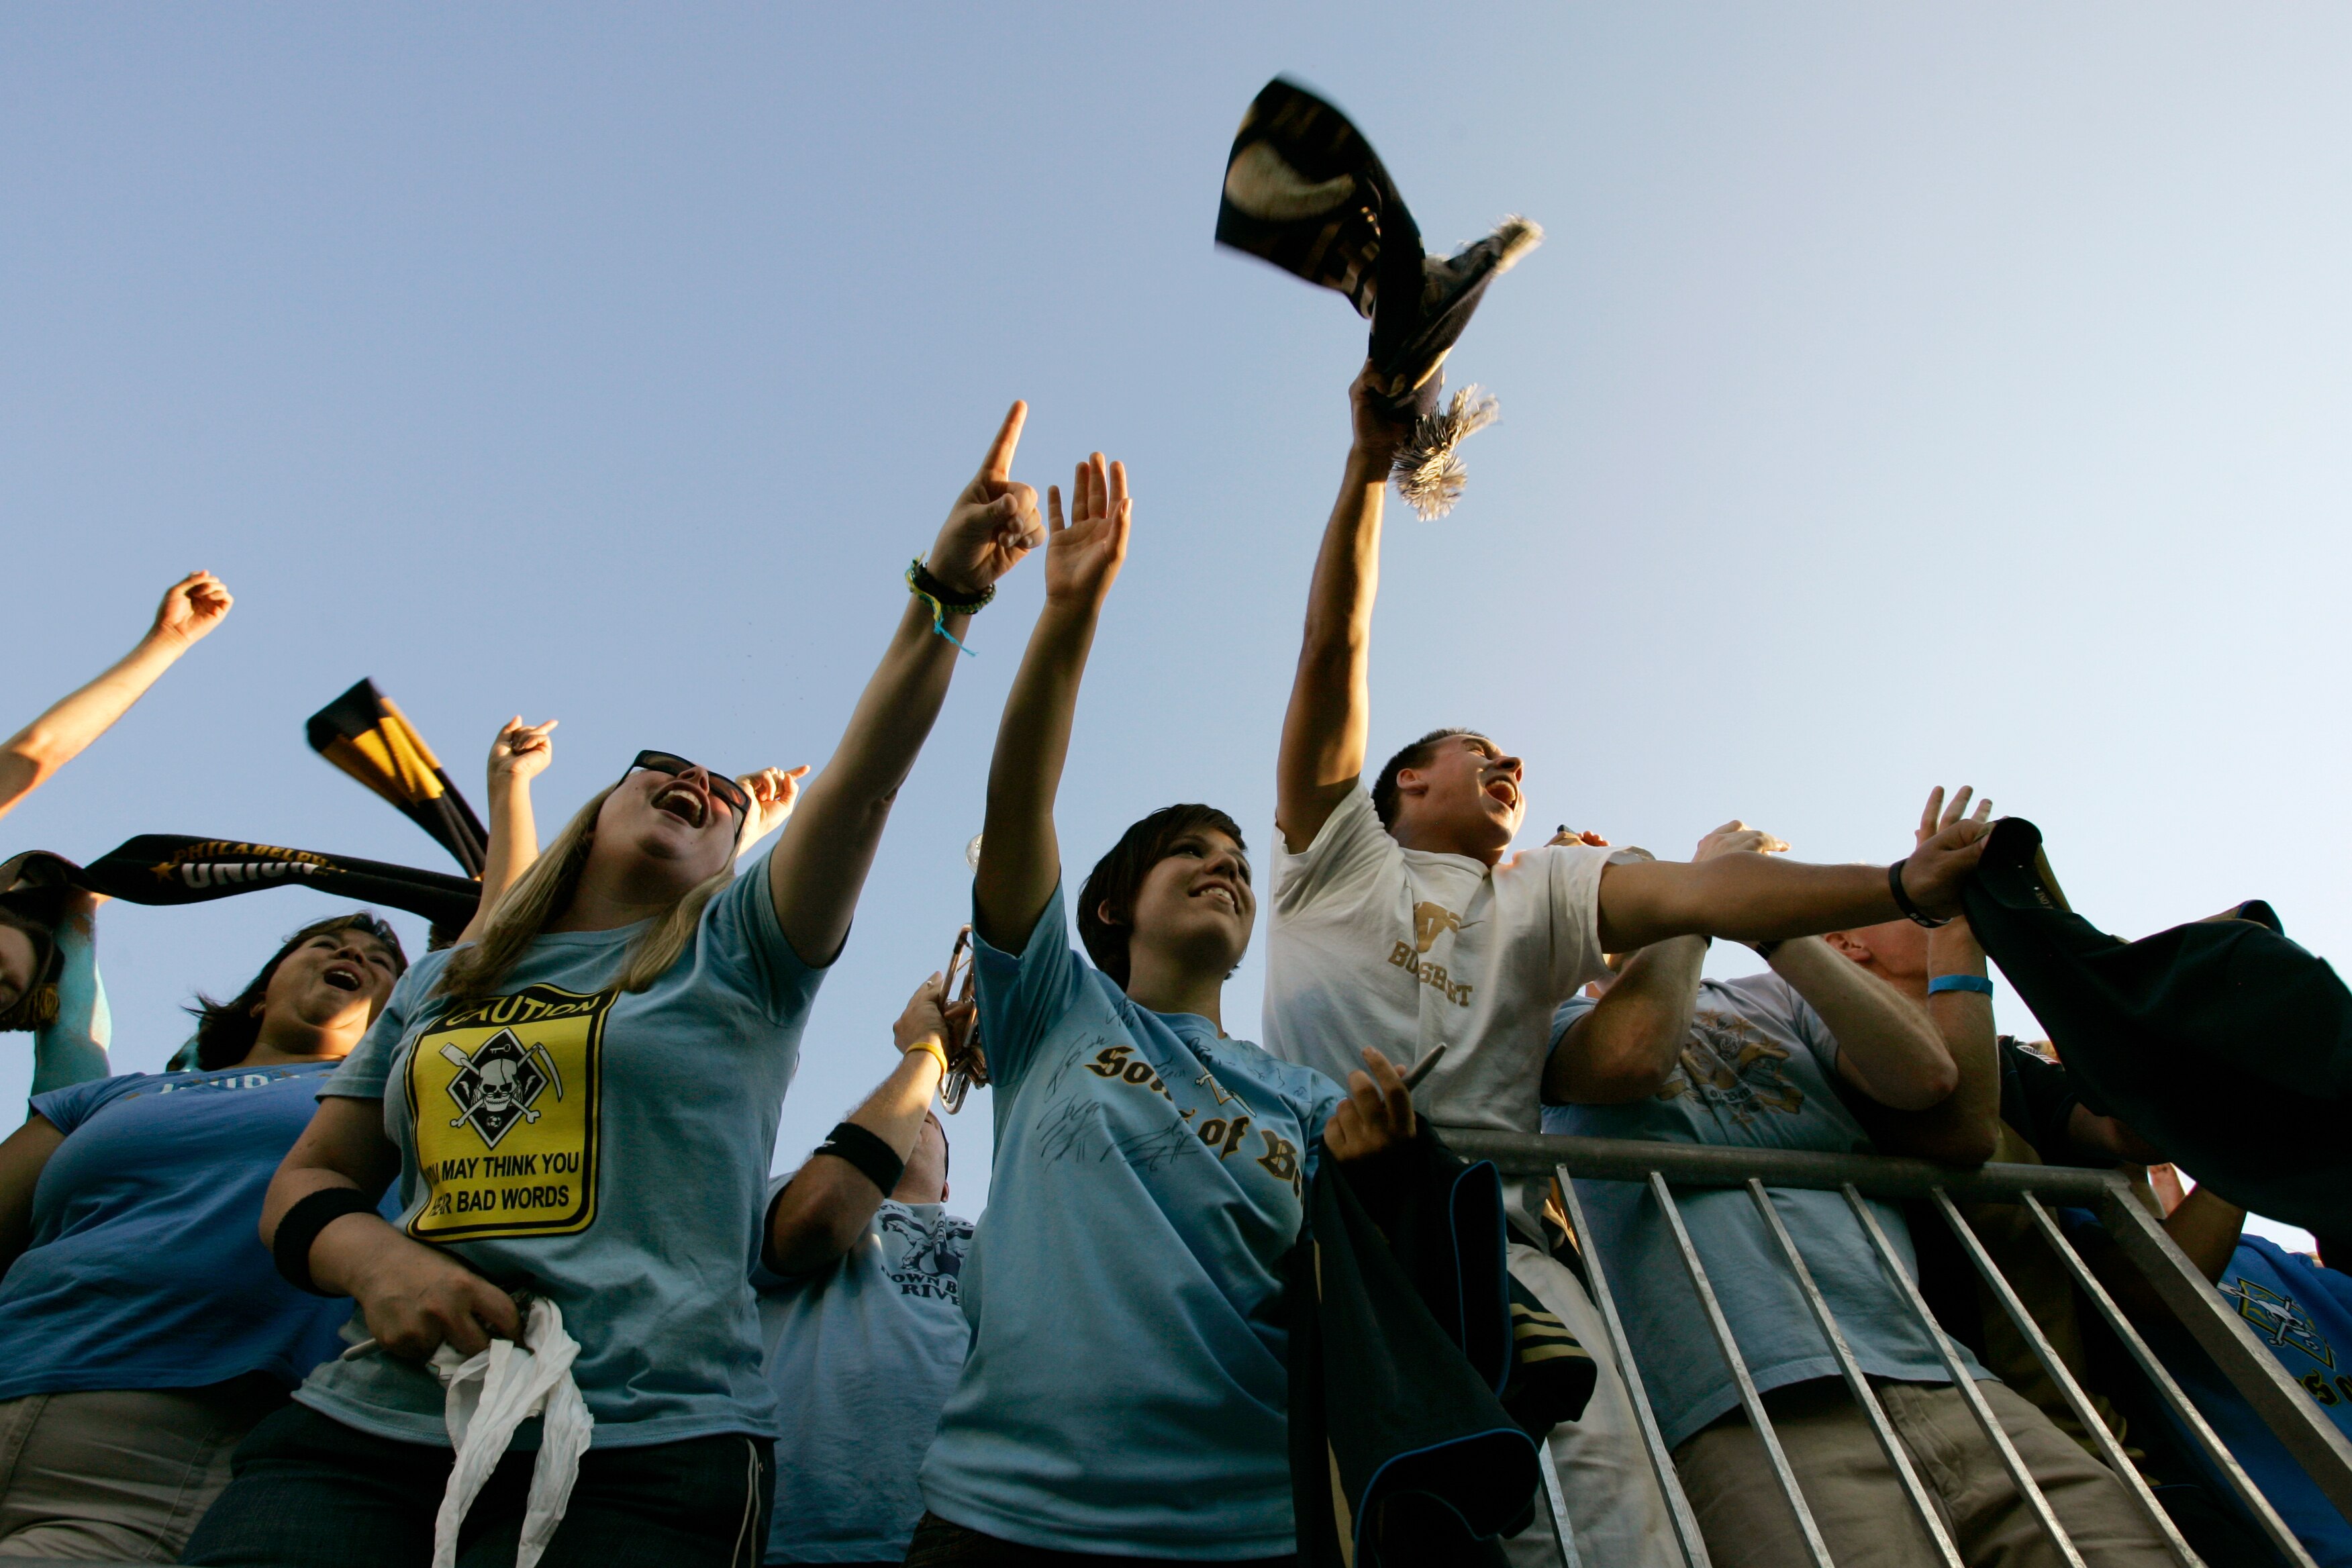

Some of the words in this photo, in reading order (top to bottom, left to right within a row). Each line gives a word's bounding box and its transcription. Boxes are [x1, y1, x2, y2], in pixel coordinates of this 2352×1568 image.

[1197, 1116, 1250, 1160] of
[442, 1157, 479, 1181] MAY
[483, 1154, 536, 1178] THINK
[542, 1152, 579, 1173] YOU
[456, 1189, 496, 1213] BAD
[501, 1185, 569, 1209] WORDS
